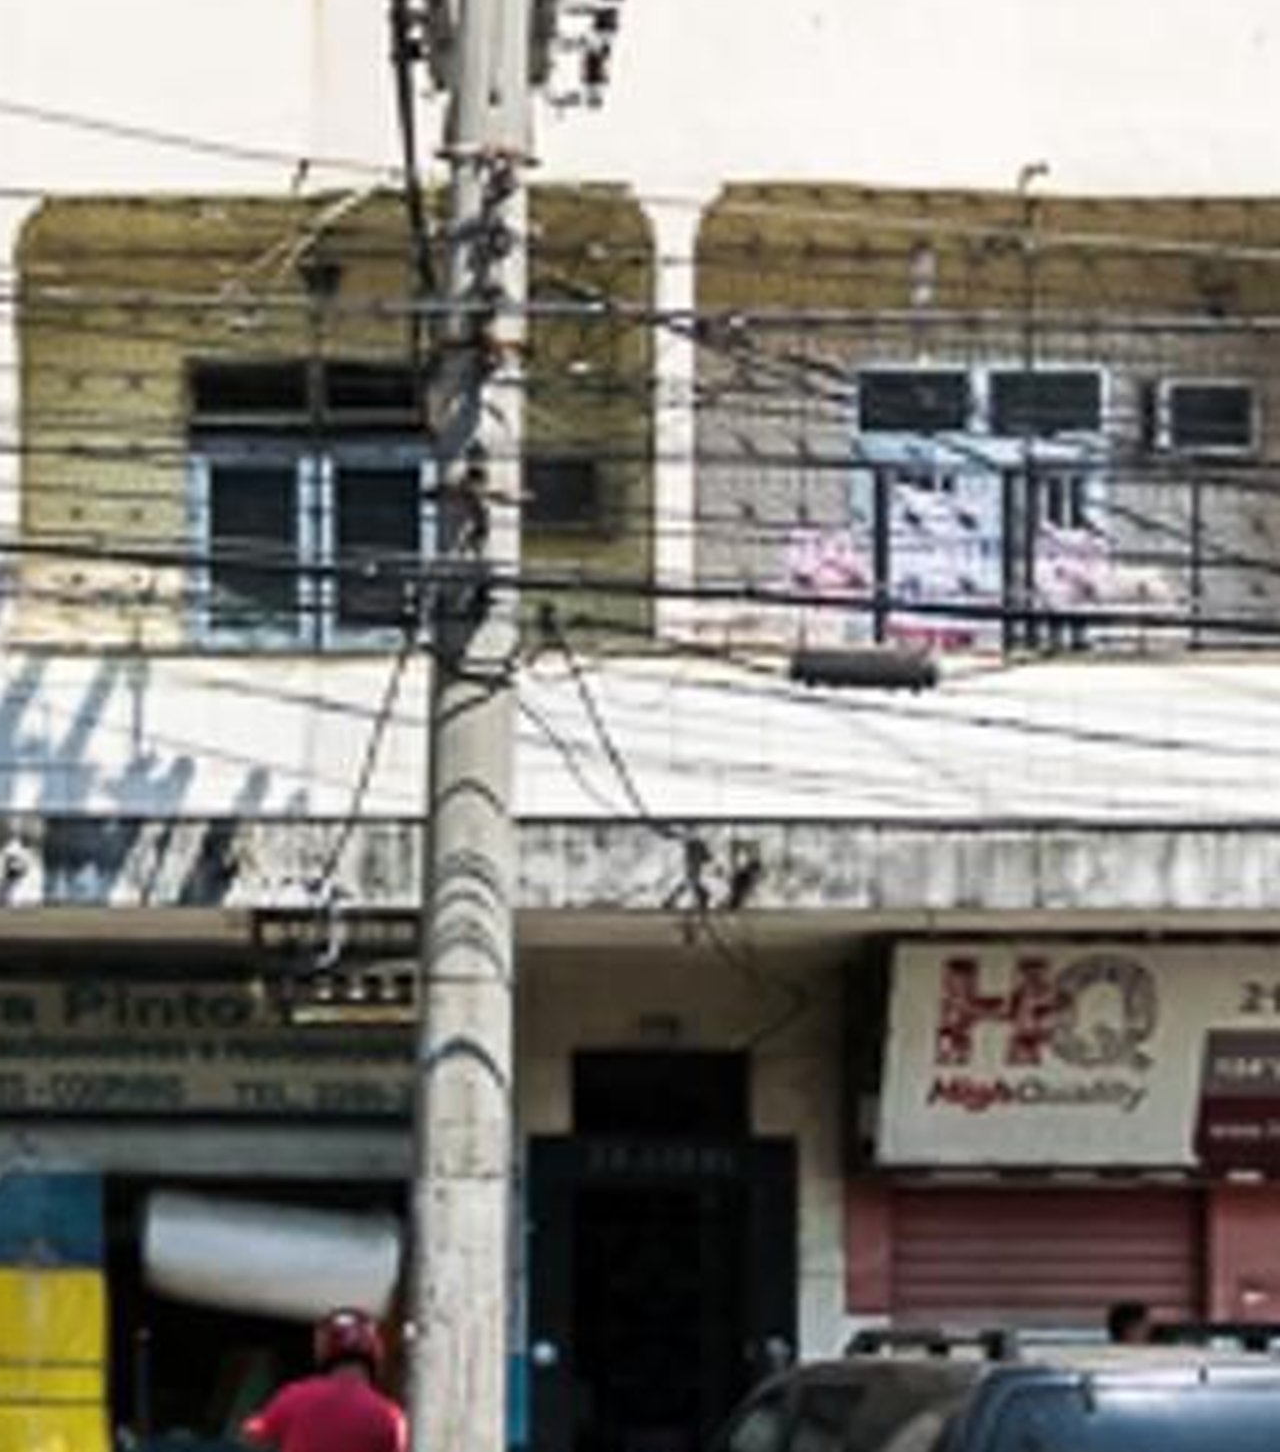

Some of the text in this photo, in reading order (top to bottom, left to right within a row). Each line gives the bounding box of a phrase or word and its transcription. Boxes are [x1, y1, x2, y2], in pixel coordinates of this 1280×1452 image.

[64, 978, 251, 1028] Pinto
[935, 954, 1158, 1071] HQ
[927, 1076, 1146, 1112] HighQuality
